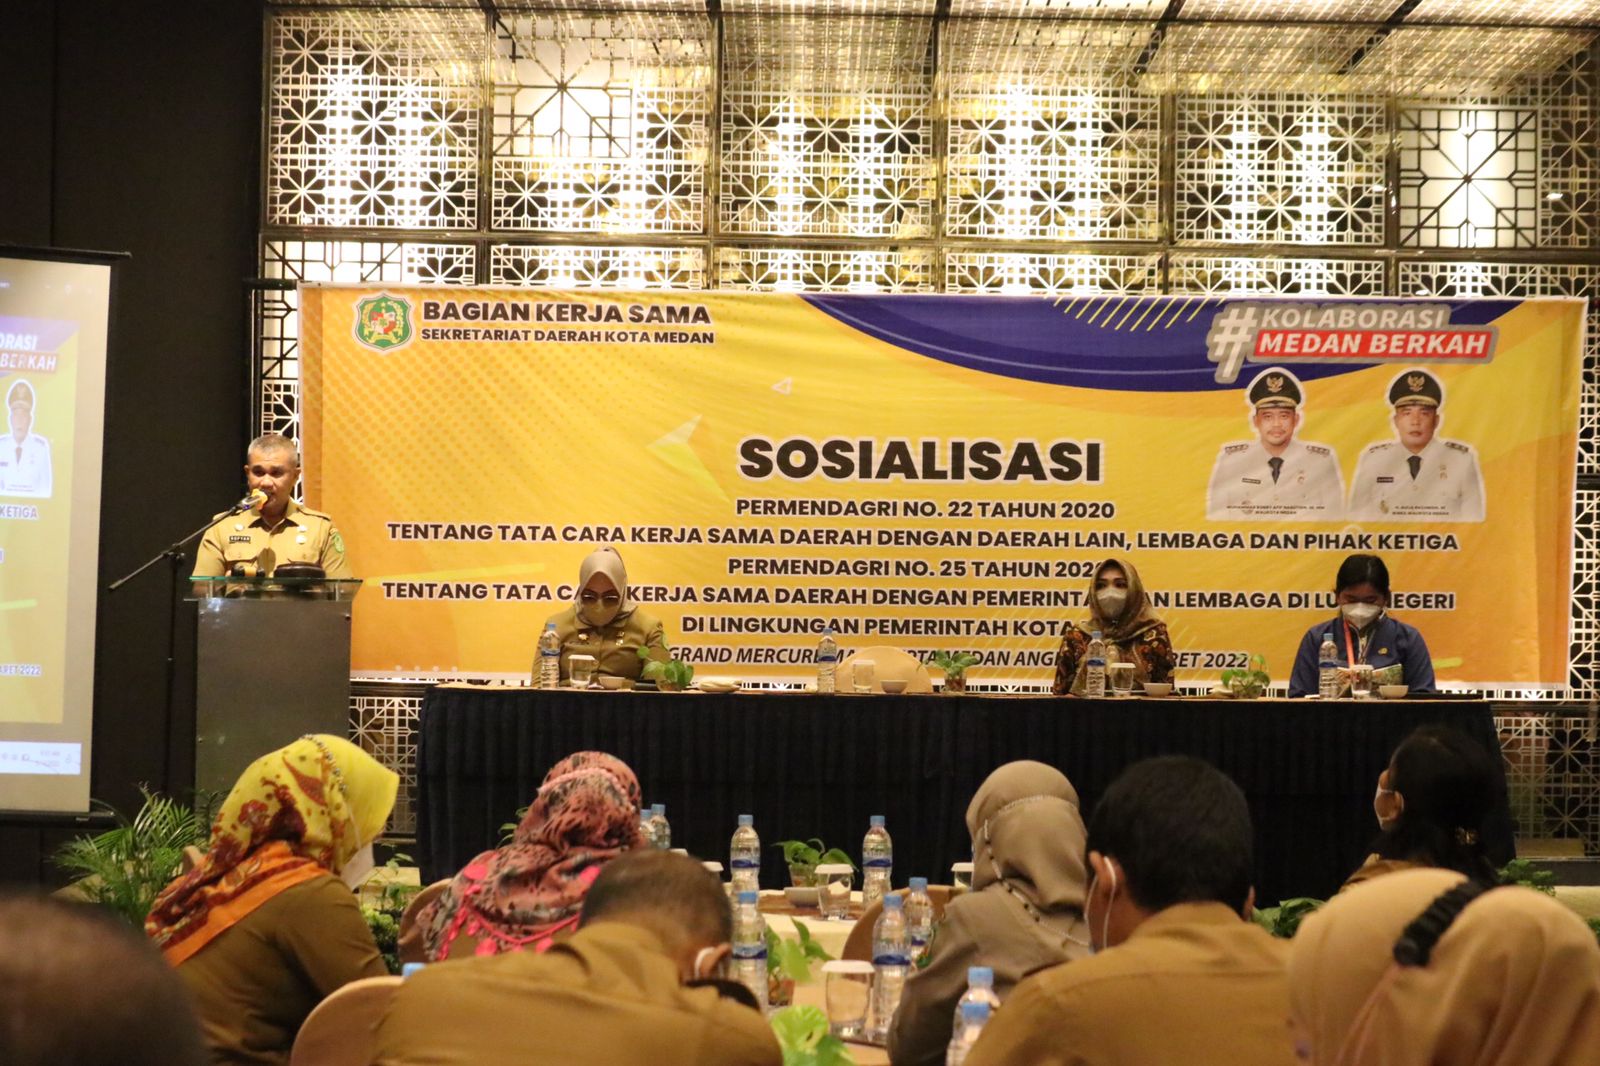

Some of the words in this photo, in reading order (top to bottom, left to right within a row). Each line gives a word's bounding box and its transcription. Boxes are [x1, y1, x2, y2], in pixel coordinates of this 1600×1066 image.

[425, 303, 530, 320] BAGIAN
[537, 305, 623, 322] KERJA
[630, 306, 710, 324] SAMA
[1261, 308, 1445, 329] KOLABORASI
[422, 329, 531, 341] SEKRETARIAT
[535, 331, 601, 342] DAERAH
[606, 332, 651, 343] KOTA
[655, 333, 713, 344] MEDAN
[1260, 333, 1362, 353] MEDAN
[1369, 334, 1487, 355] BERKAH
[740, 439, 1100, 482] SOSIALISASI
[737, 500, 898, 517] PERMENDAGRI
[904, 502, 943, 517] NO.
[948, 502, 973, 517] 22
[978, 502, 1056, 518] TAHUN
[1060, 503, 1115, 519] 2020
[388, 524, 493, 540] TENTANG
[497, 526, 557, 541] TATA
[563, 527, 626, 542] CARA
[632, 528, 703, 543] KERJA
[708, 528, 775, 545] SAMA
[781, 530, 872, 546] DAERAH
[877, 531, 972, 547] DENGAN
[978, 532, 1070, 548] DAERAH
[1075, 532, 1132, 551] LAIN,
[1138, 533, 1245, 549] LEMBAGA
[1251, 534, 1299, 550] DAN
[1304, 534, 1373, 550] PIHAK
[1378, 534, 1458, 550] KETIGA
[729, 559, 890, 576] PERMENDAGRI
[896, 561, 935, 577] NO.
[940, 561, 967, 577] 25
[971, 561, 1050, 578] TAHUN
[1055, 562, 1101, 578] 202
[383, 583, 488, 599] TENTANG
[493, 585, 552, 600] TATA
[627, 586, 698, 603] KERJA
[702, 587, 770, 604] SAMA
[776, 589, 867, 605] DAERAH
[873, 590, 967, 606] DENGAN
[1175, 592, 1283, 609] LEMBAGA
[1288, 593, 1310, 609] DI
[683, 617, 704, 632] DI
[710, 617, 859, 634] LINGKUNGAN
[865, 619, 1008, 636] PEMERINTAH
[1014, 621, 1074, 637] KOTA
[669, 647, 732, 663] GRAND
[1204, 652, 1248, 668] 2022
